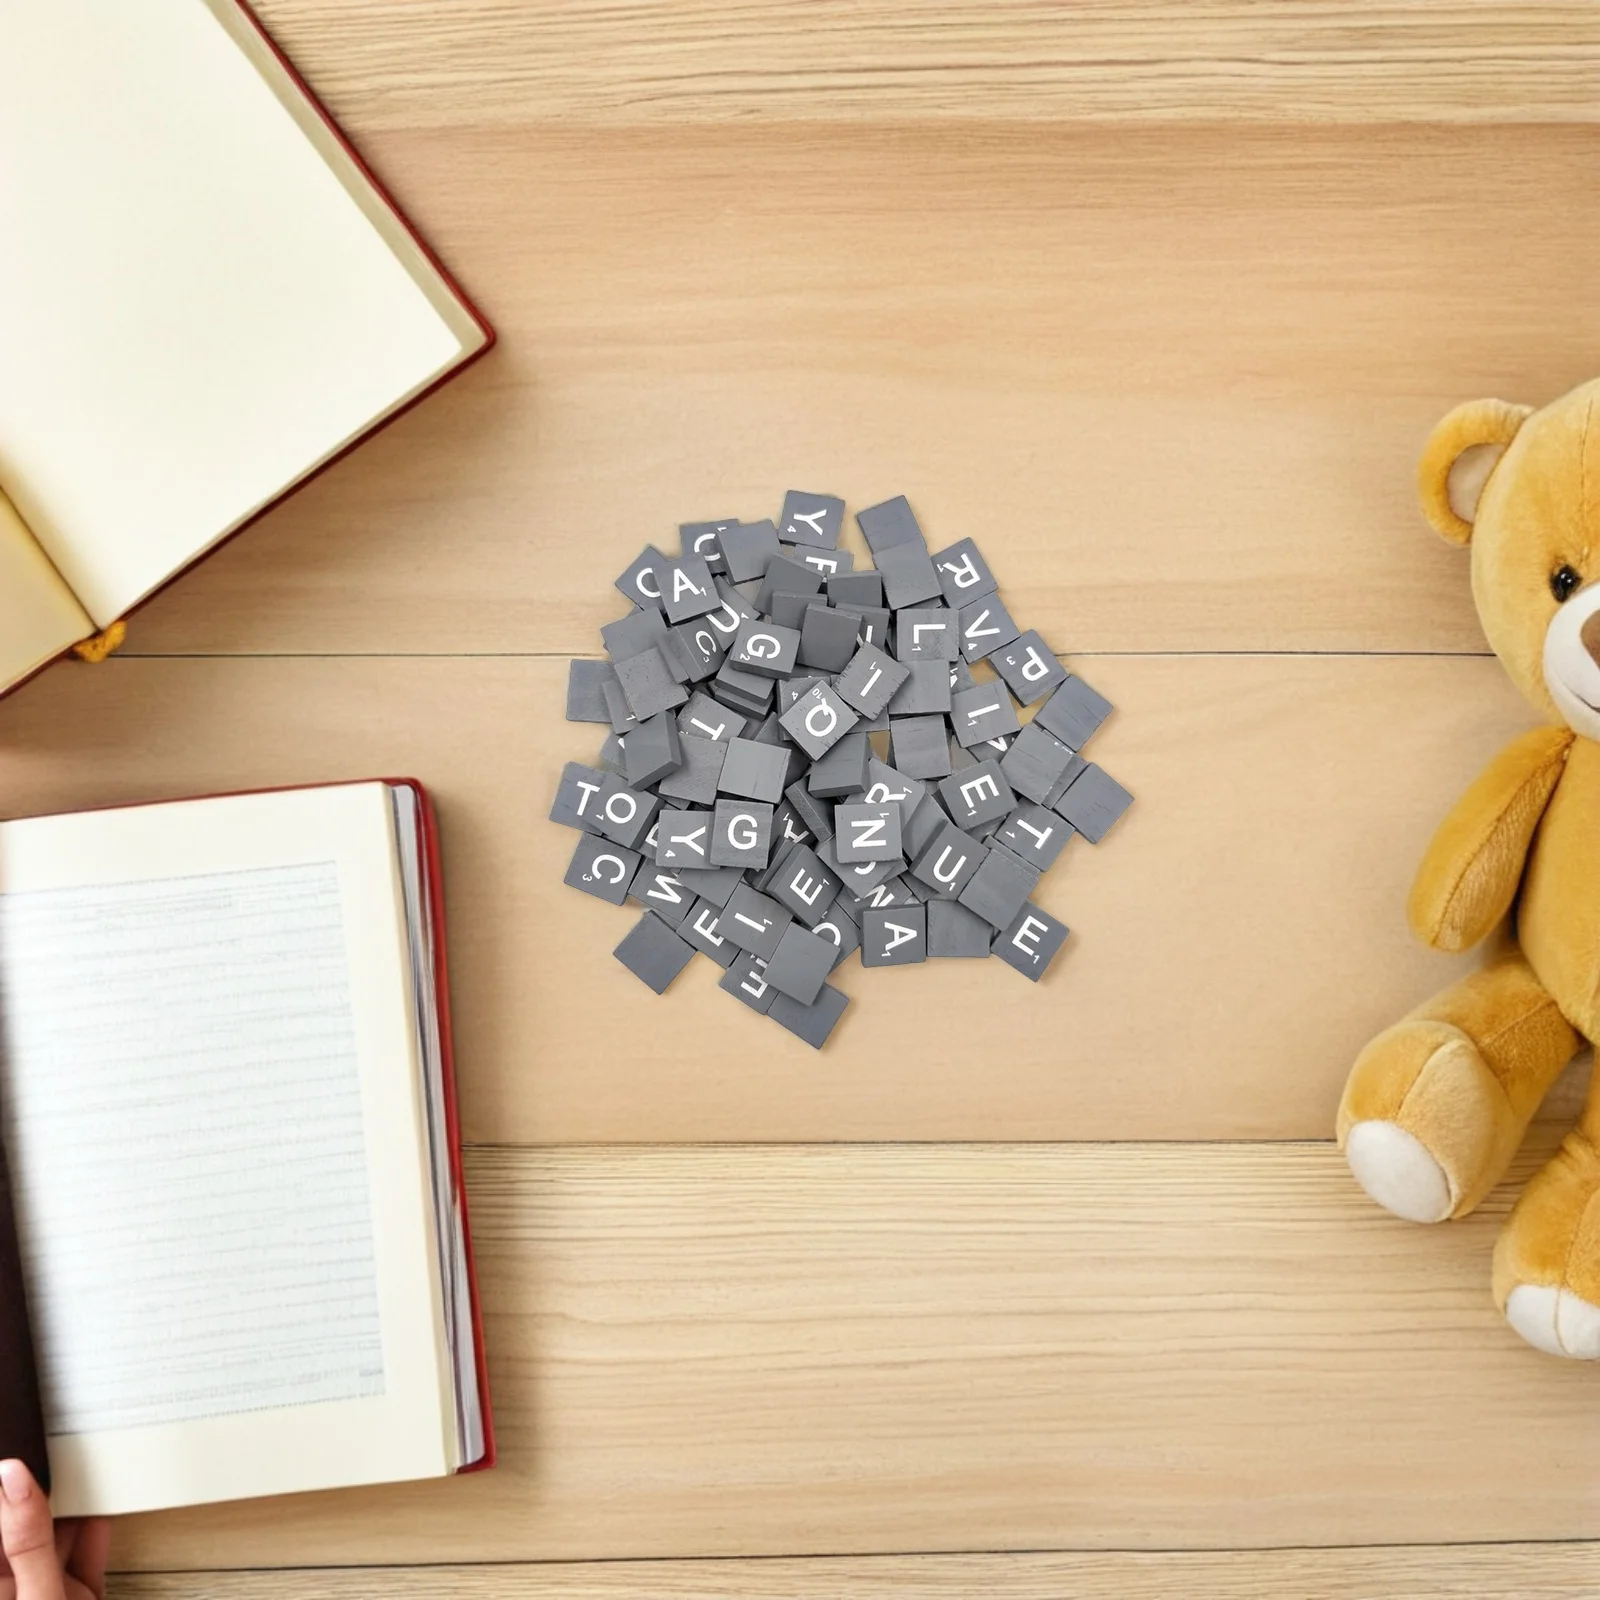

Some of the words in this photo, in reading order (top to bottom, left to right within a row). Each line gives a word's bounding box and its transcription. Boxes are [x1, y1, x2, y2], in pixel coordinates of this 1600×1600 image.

[794, 509, 828, 536] Y
[674, 568, 701, 603] A
[943, 553, 981, 589] R
[914, 624, 947, 645] L
[965, 609, 1001, 639] V
[695, 630, 717, 656] C
[746, 633, 781, 659] G
[1021, 646, 1050, 682] P
[811, 687, 823, 700] 10
[860, 668, 883, 698] I
[805, 697, 837, 738] Q
[967, 703, 1000, 719] I
[576, 780, 601, 816] T
[959, 773, 1000, 809] E
[605, 792, 637, 824] O
[670, 826, 707, 857] Y
[727, 813, 758, 850] G
[850, 819, 887, 849] N
[1016, 818, 1054, 850] T
[592, 854, 626, 884] C
[933, 845, 967, 883] U
[789, 868, 823, 906] E
[734, 912, 766, 933] I
[883, 921, 918, 950] A
[1011, 915, 1049, 956] E
